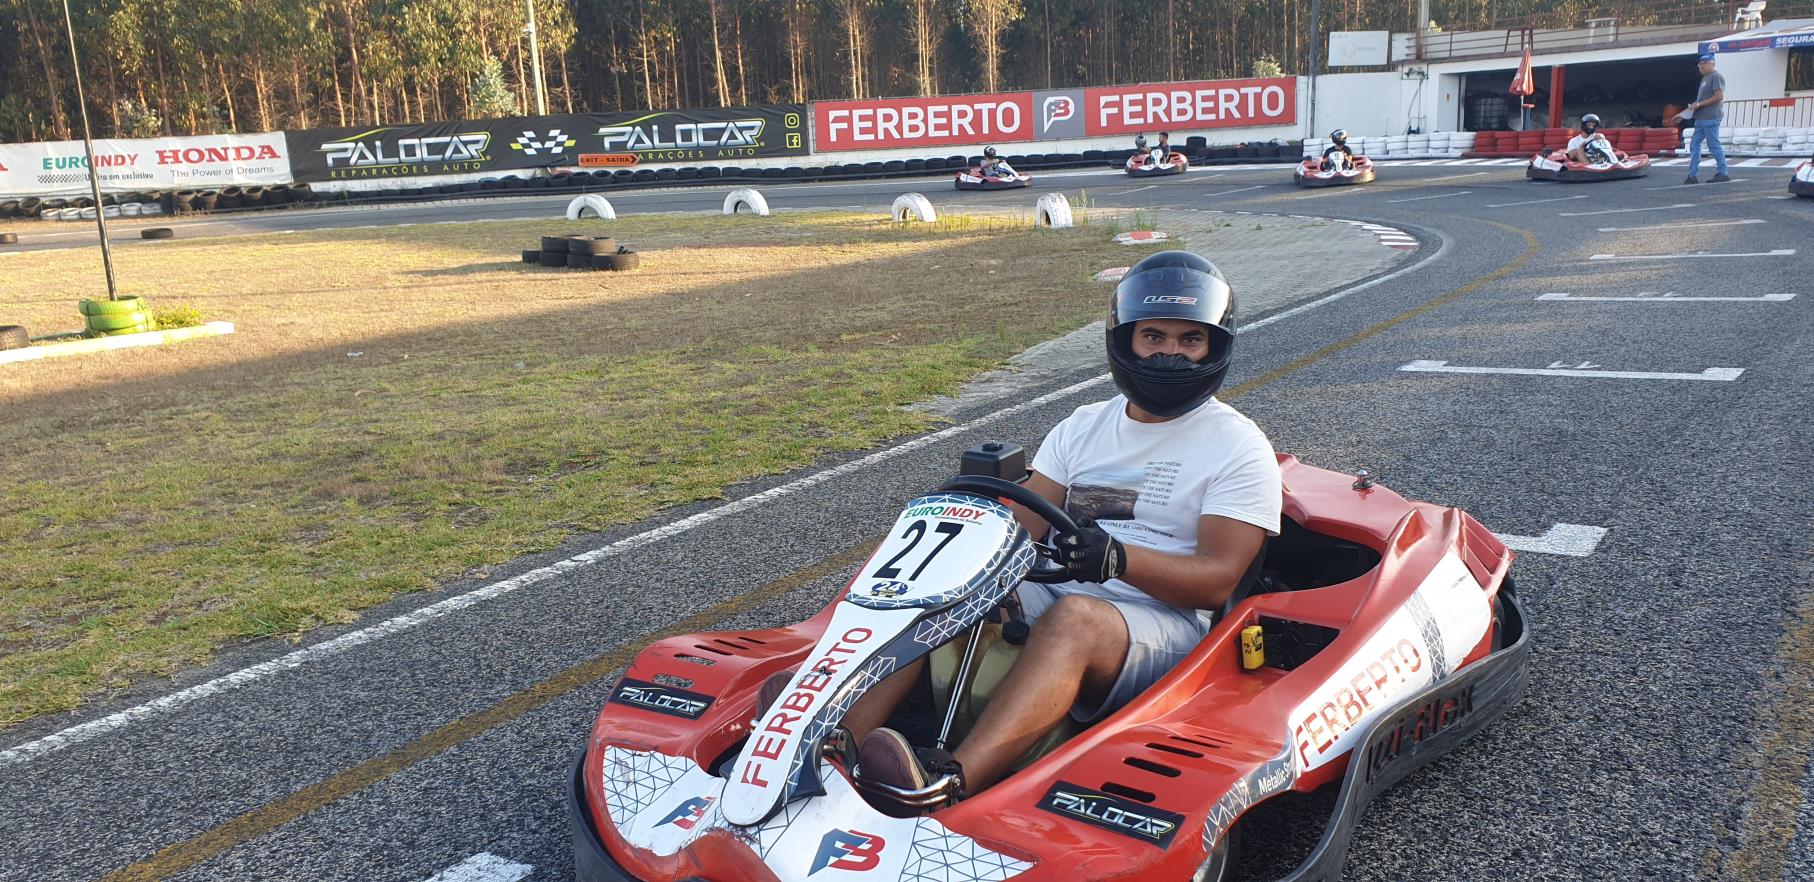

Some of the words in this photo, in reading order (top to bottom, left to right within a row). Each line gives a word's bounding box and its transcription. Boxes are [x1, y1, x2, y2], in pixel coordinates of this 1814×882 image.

[1099, 85, 1286, 127] FERBERTO
[598, 119, 765, 151] PALOCAR
[828, 101, 1021, 142] FERBERTO
[155, 145, 281, 165] HONDA
[320, 133, 491, 168] PALOCAR
[638, 150, 704, 161] ARAÇÕES
[718, 148, 755, 157] AUTO
[122, 171, 154, 180] exclusivo
[170, 169, 189, 178] The
[192, 168, 222, 177] Power
[224, 168, 234, 176] of
[236, 166, 275, 175] Dreams
[331, 164, 429, 178] REPARAÇÕES
[443, 162, 481, 172] AUTO
[903, 506, 986, 520] EUROINDY
[872, 519, 964, 581] 27
[618, 686, 708, 714] PALOCAR
[740, 627, 873, 788] FERBERTO
[1258, 767, 1286, 795] Metallic
[1052, 791, 1175, 838] PALOCAR
